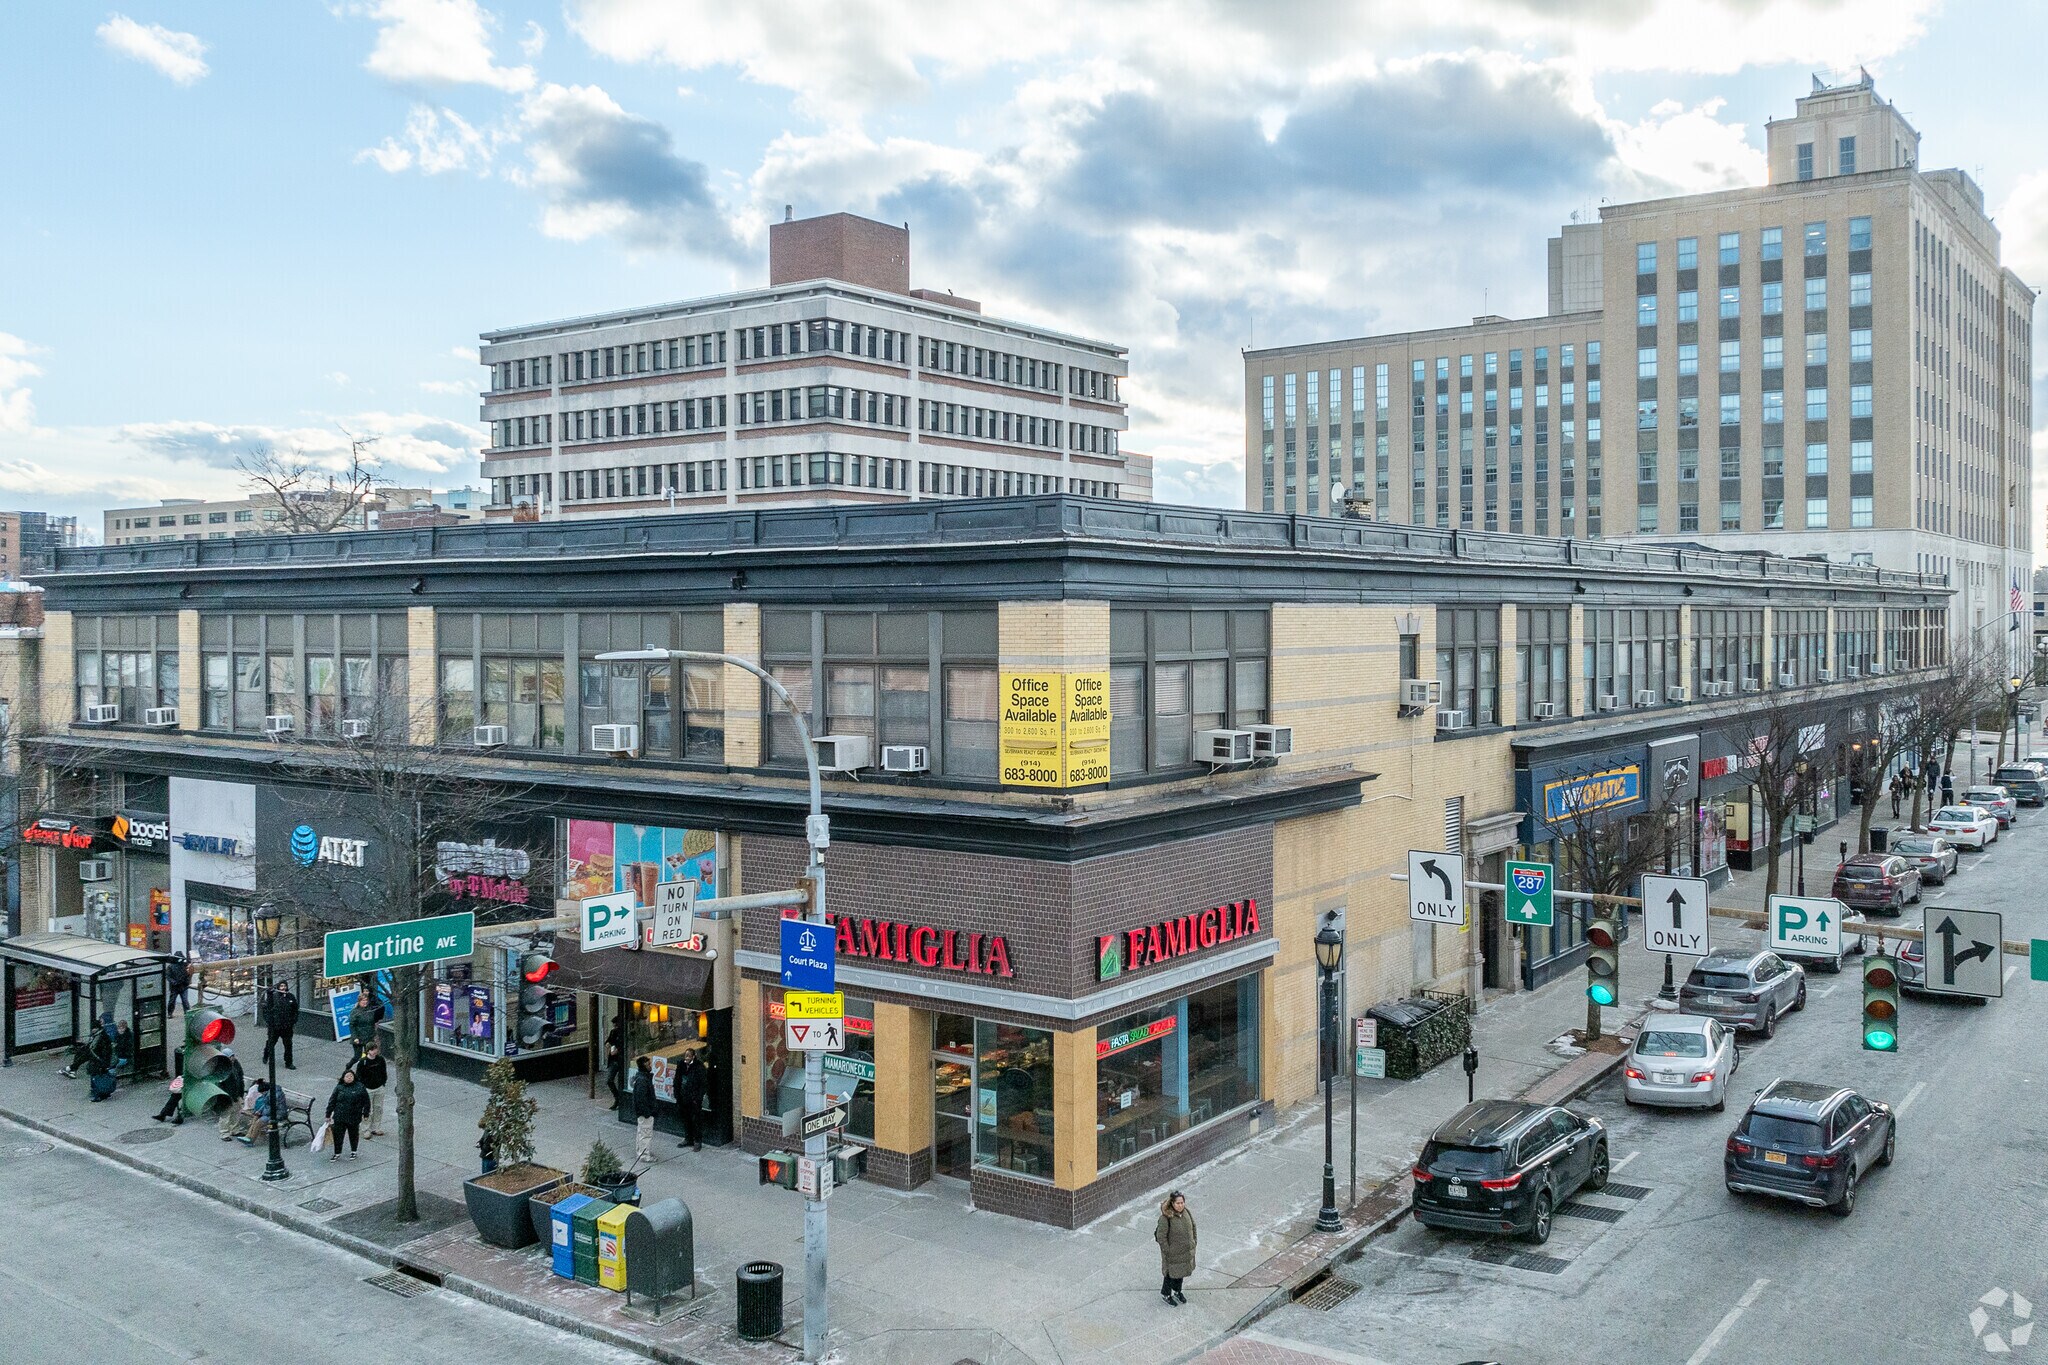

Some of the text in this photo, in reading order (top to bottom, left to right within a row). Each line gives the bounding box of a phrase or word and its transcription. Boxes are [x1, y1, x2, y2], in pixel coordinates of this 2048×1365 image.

[1011, 677, 1049, 692] Office
[1075, 678, 1102, 692] Office
[1011, 693, 1050, 709] Space
[1074, 694, 1103, 709] Space
[1004, 708, 1057, 722] Available
[1069, 707, 1108, 723] Available
[1020, 759, 1041, 768] (914)
[1081, 758, 1097, 767] (914)
[1004, 767, 1058, 783] 683-8000
[1069, 765, 1108, 783] 683-8000
[129, 818, 169, 841] boost
[131, 837, 153, 847] mobile
[183, 834, 238, 856] JEWELRY
[317, 836, 369, 868] AT&T
[1518, 876, 1542, 890] 287
[667, 886, 685, 900] NO
[662, 901, 689, 914] TURN
[1417, 901, 1457, 919] ONLY
[667, 916, 681, 927] ON
[662, 929, 683, 940] RED
[1125, 899, 1261, 972] FAMIGLIA
[1653, 930, 1701, 950] ONLY
[342, 934, 458, 965] Martine AVE
[788, 955, 808, 967] Court
[808, 958, 828, 970] Plaza
[806, 996, 837, 1005] TURNING
[804, 1007, 839, 1015] VEHICLES
[812, 1030, 822, 1039] TO
[1111, 1033, 1130, 1049] PASTA
[824, 1056, 867, 1077] MAMARONECK
[806, 1112, 836, 1133] ONE WAY
